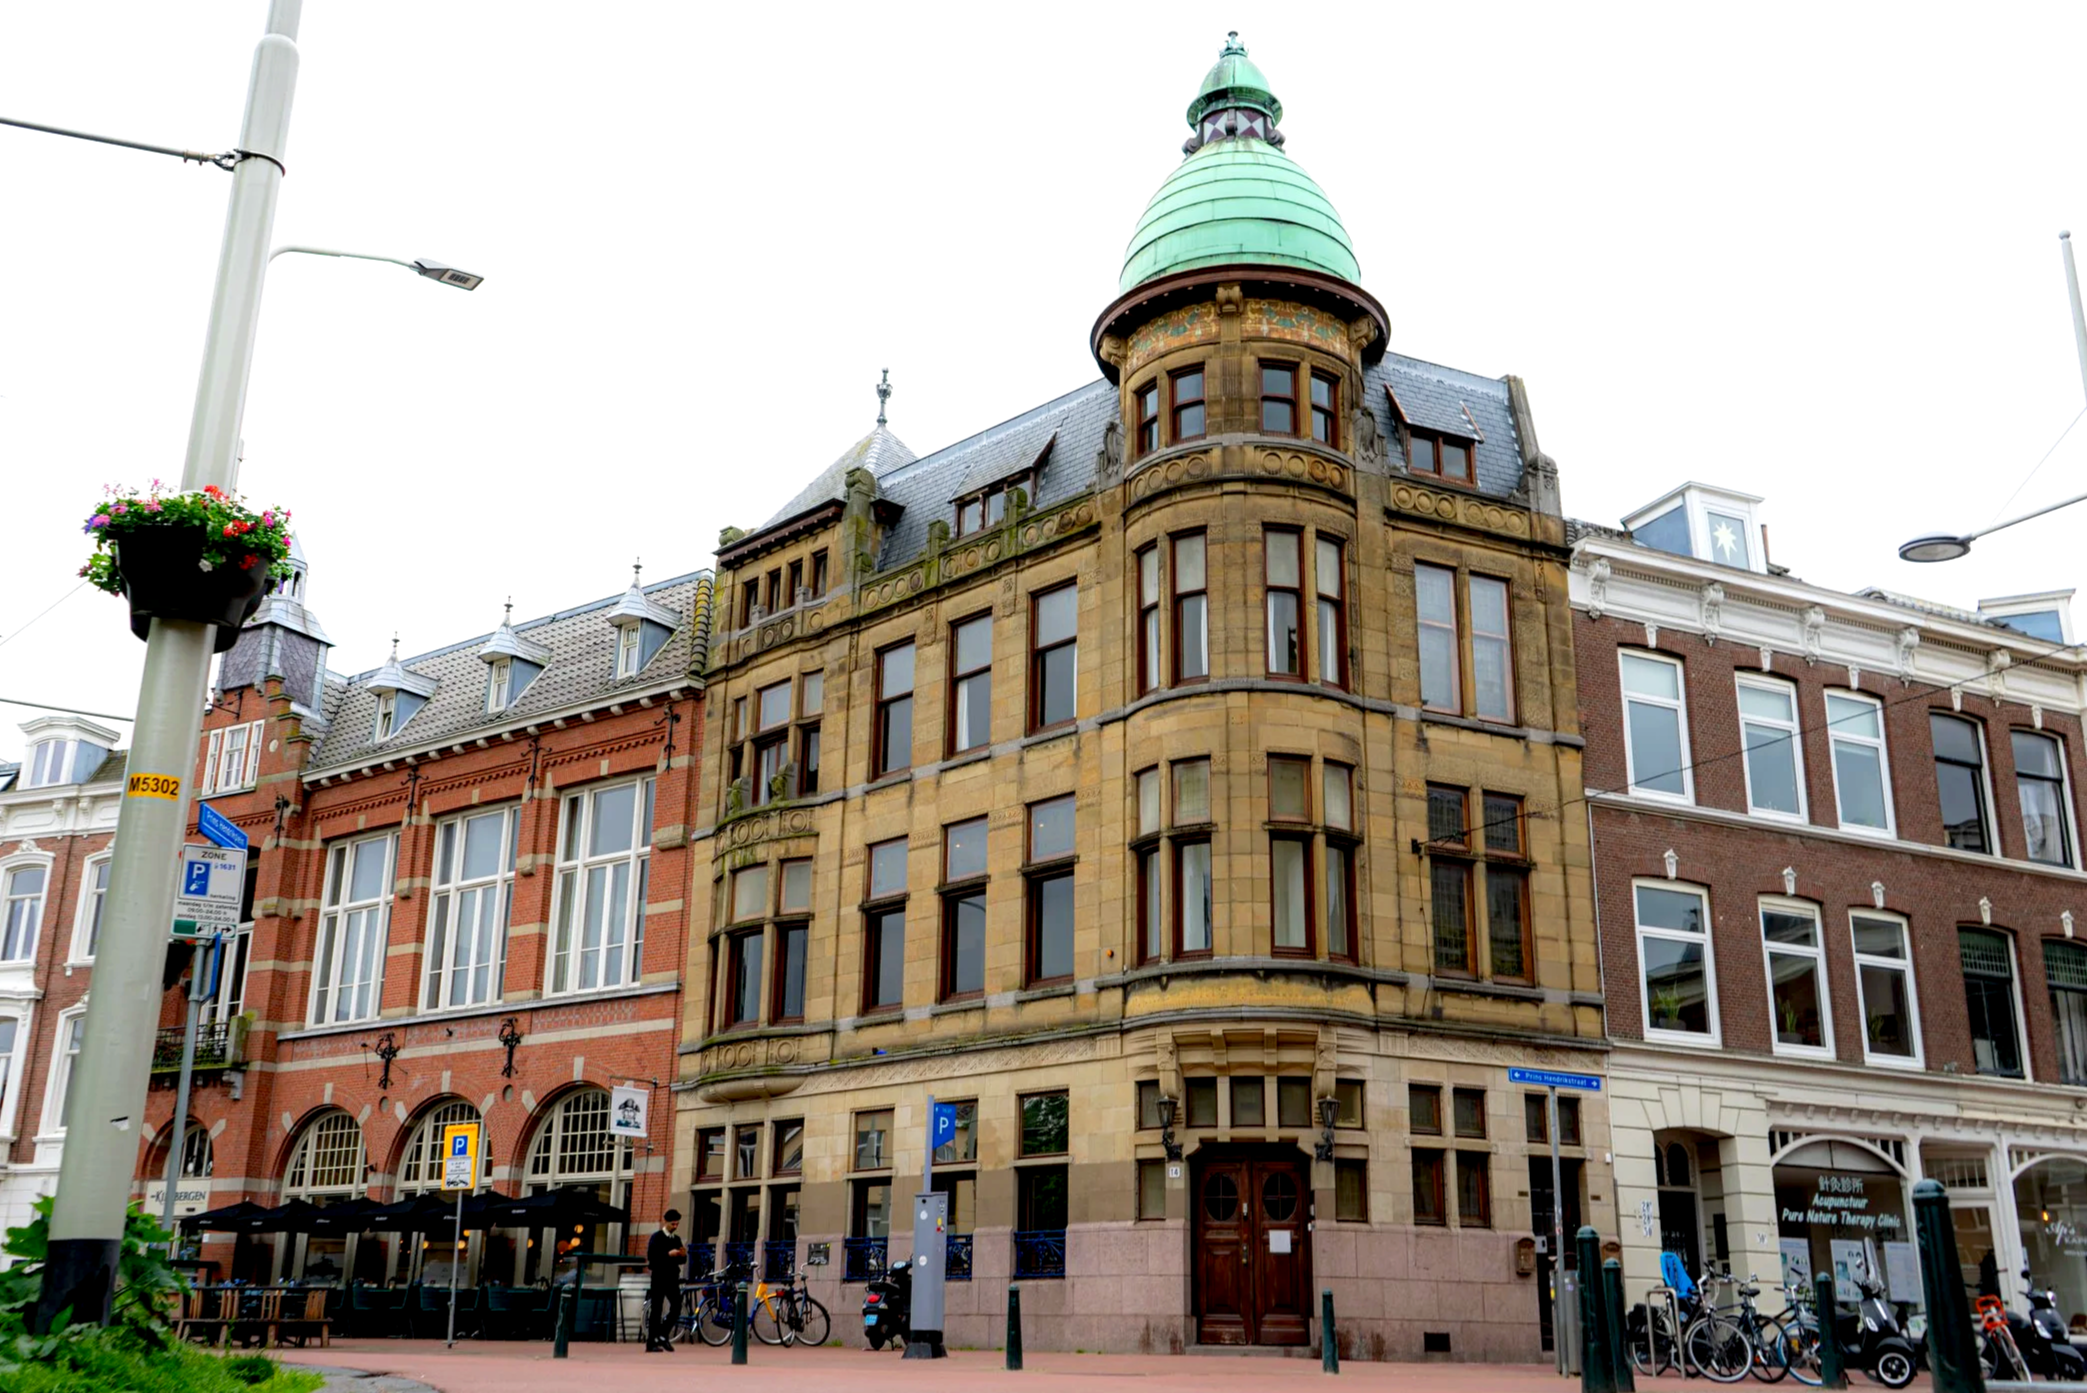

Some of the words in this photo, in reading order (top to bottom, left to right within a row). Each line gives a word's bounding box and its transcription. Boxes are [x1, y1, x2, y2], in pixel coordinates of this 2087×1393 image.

[129, 777, 179, 796] M5302
[201, 851, 228, 861] ZONE
[192, 863, 206, 879] P
[1525, 1072, 1542, 1081] Prins
[1544, 1075, 1587, 1087] Hendrikstraat
[939, 1116, 950, 1135] P
[455, 1138, 466, 1154] P
[1812, 1192, 1869, 1210] Acupunctuur
[1782, 1207, 1804, 1223] Pure
[1806, 1208, 1838, 1225] Nature
[1840, 1210, 1876, 1230] Therapy
[1877, 1213, 1901, 1229] Clinic
